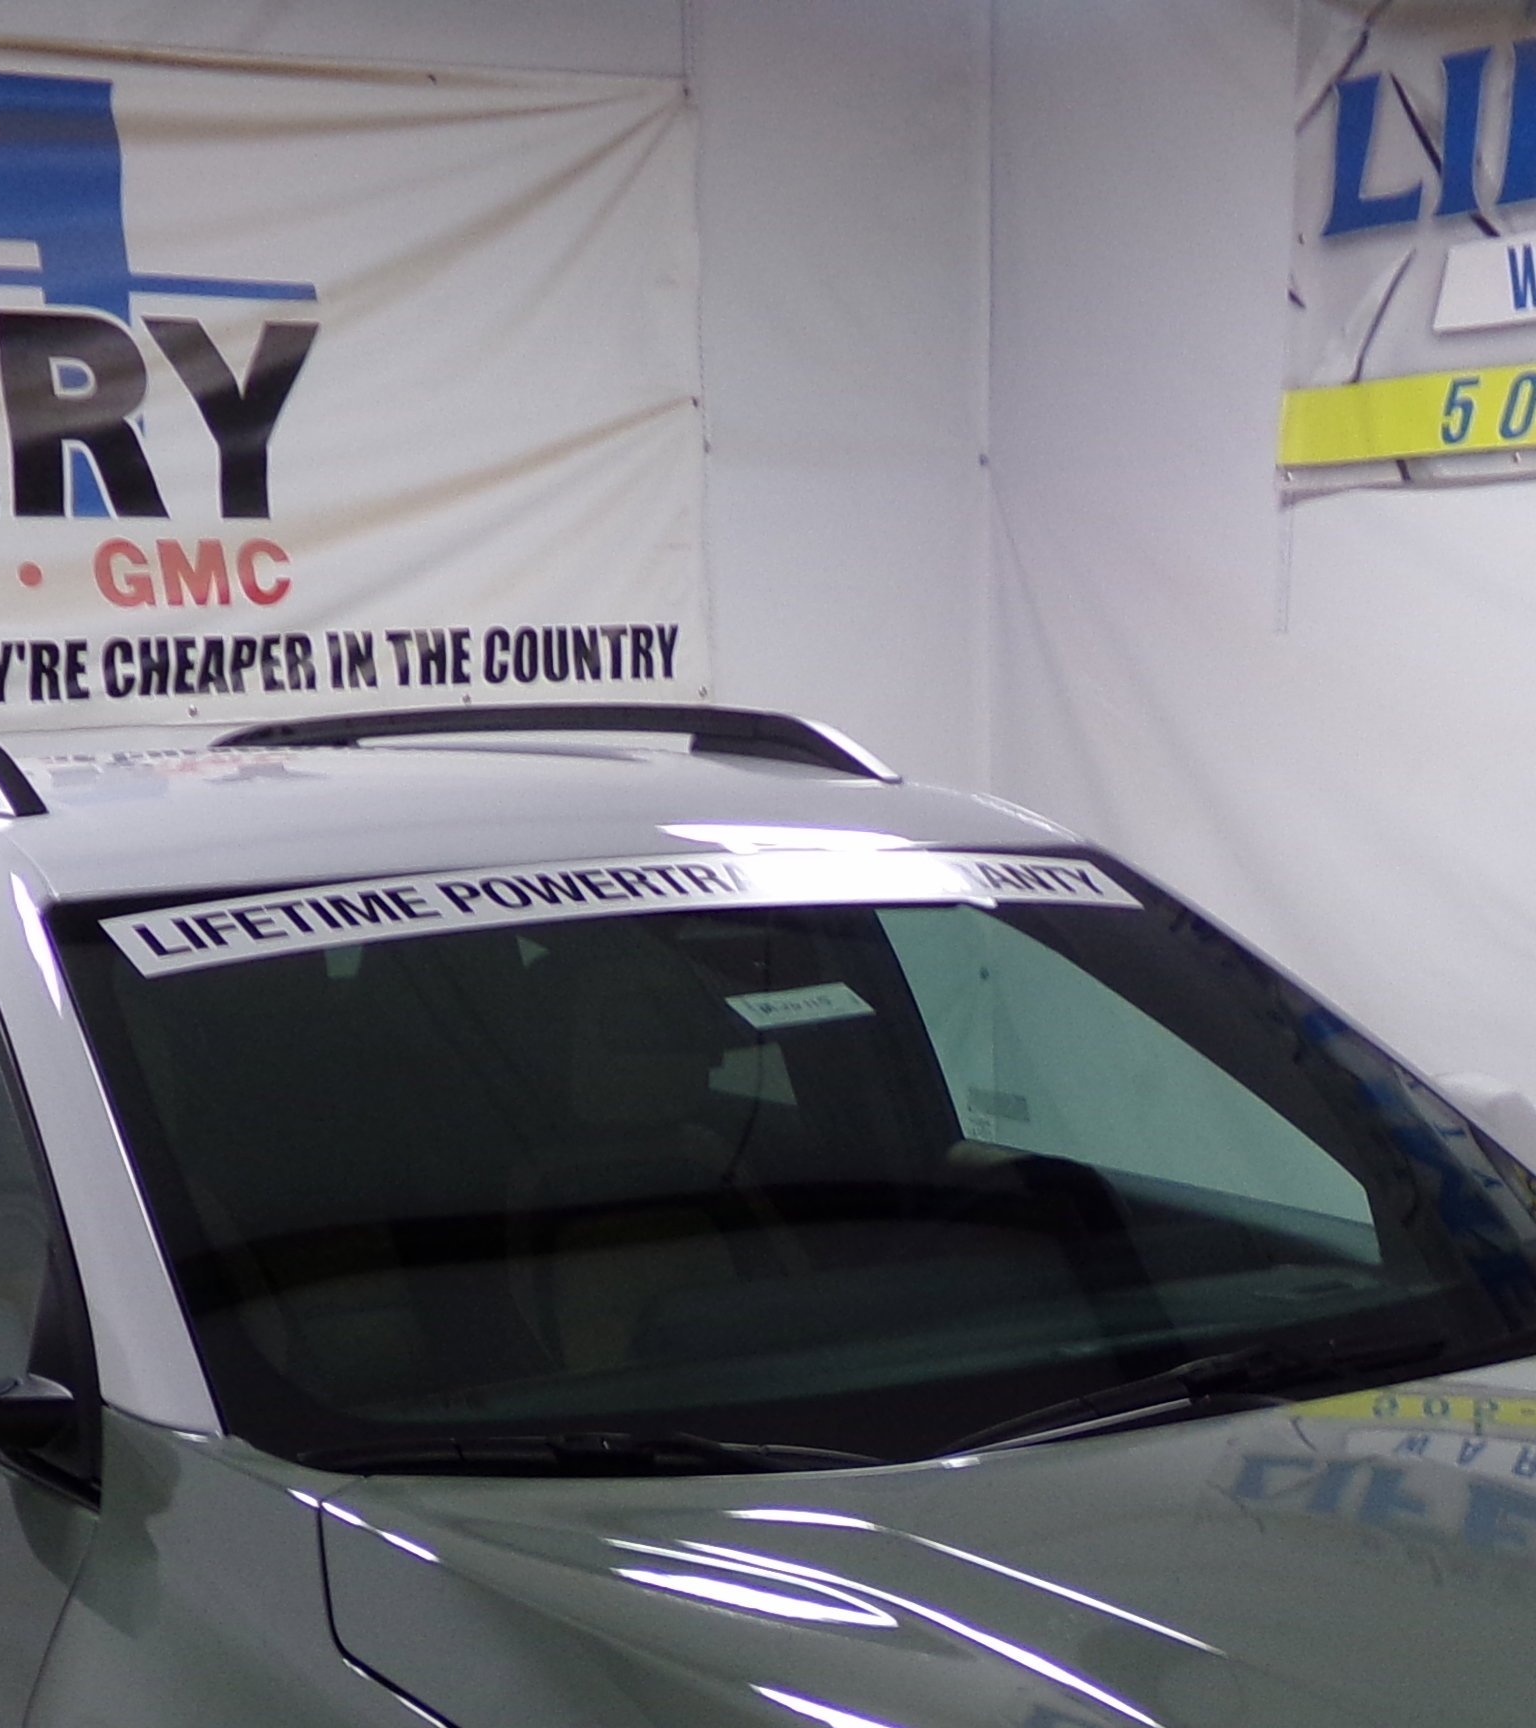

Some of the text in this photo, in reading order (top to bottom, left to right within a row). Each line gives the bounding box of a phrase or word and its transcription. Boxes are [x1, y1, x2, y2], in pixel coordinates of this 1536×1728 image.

[93, 537, 293, 608] GMC
[101, 631, 317, 699] CHEAPER
[324, 630, 378, 690] IN
[385, 628, 472, 687] THE
[482, 624, 679, 685] COUNTRY
[132, 885, 442, 958] LIFETIME
